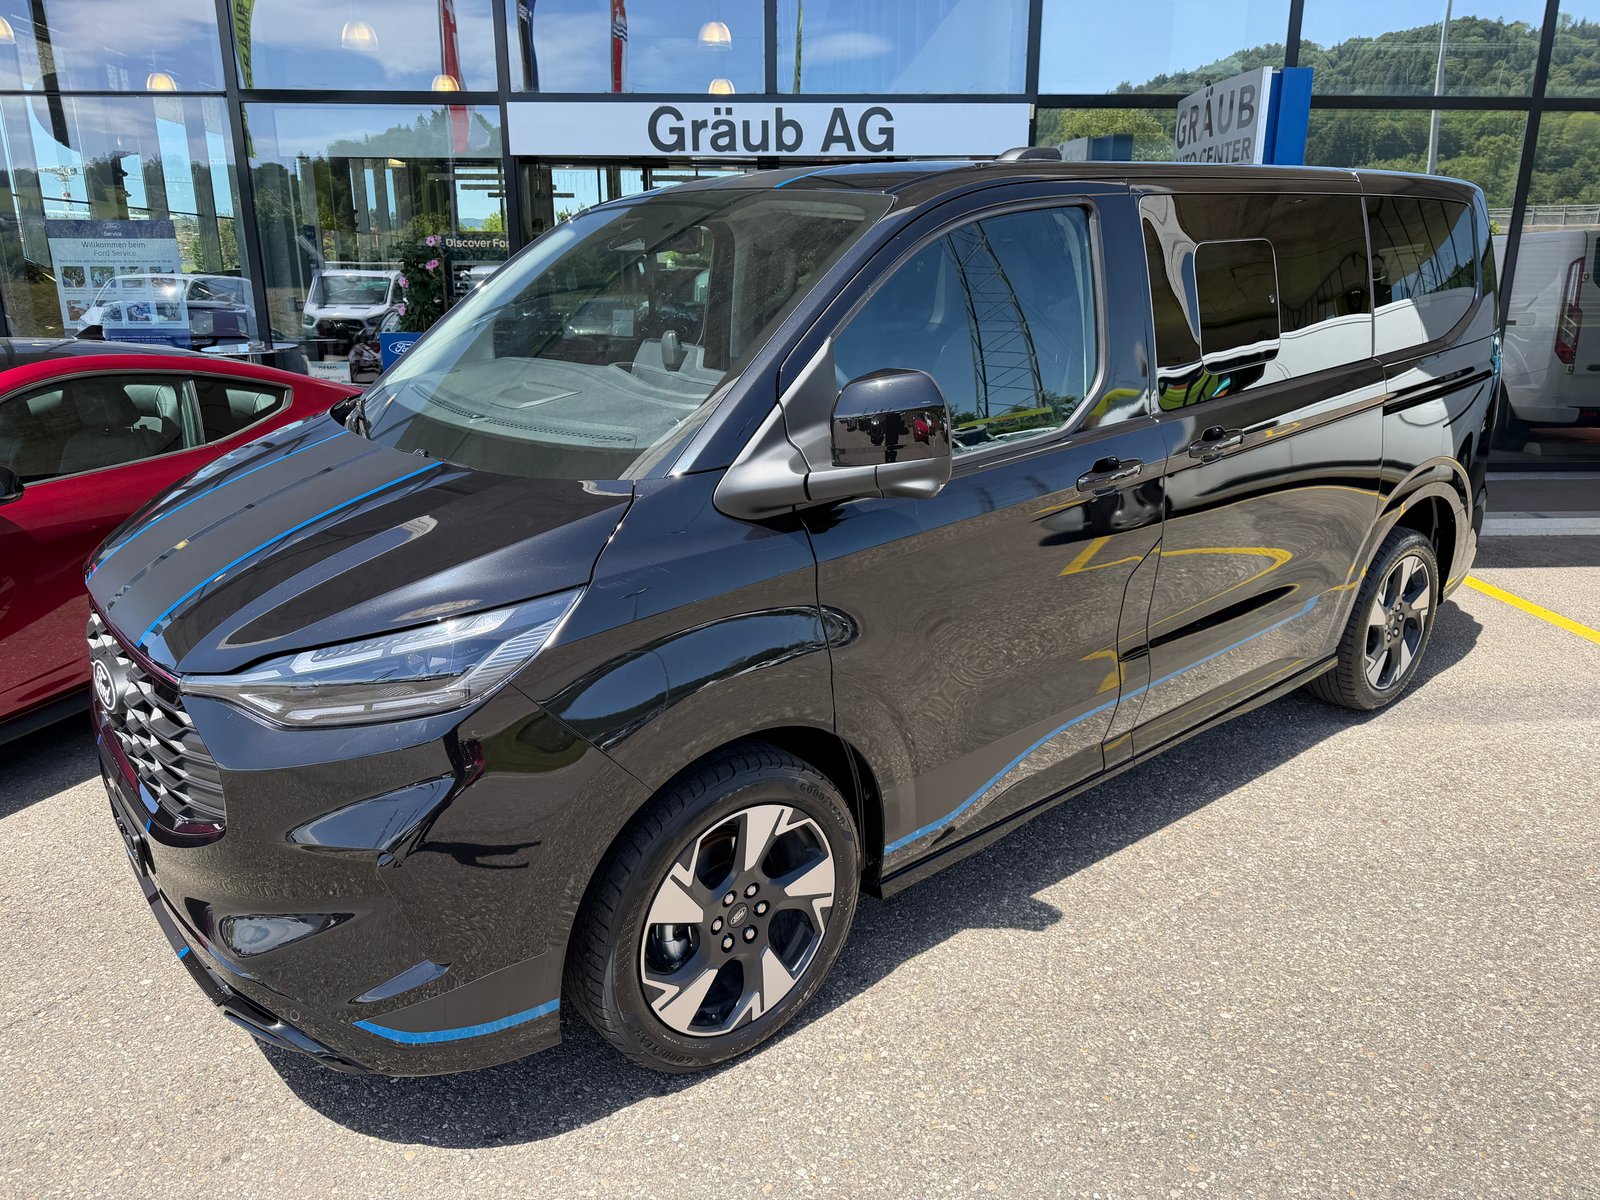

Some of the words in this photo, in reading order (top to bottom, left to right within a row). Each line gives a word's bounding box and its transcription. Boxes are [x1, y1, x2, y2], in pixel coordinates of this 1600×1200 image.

[1176, 84, 1256, 149] GRÄUB
[647, 105, 803, 153] Gräub
[820, 106, 895, 153] AG
[1200, 137, 1251, 163] CENTER
[81, 241, 127, 249] Willkommen
[128, 241, 146, 249] beim
[445, 238, 491, 248] Discover
[93, 249, 110, 257] Ford
[112, 249, 137, 257] Service
